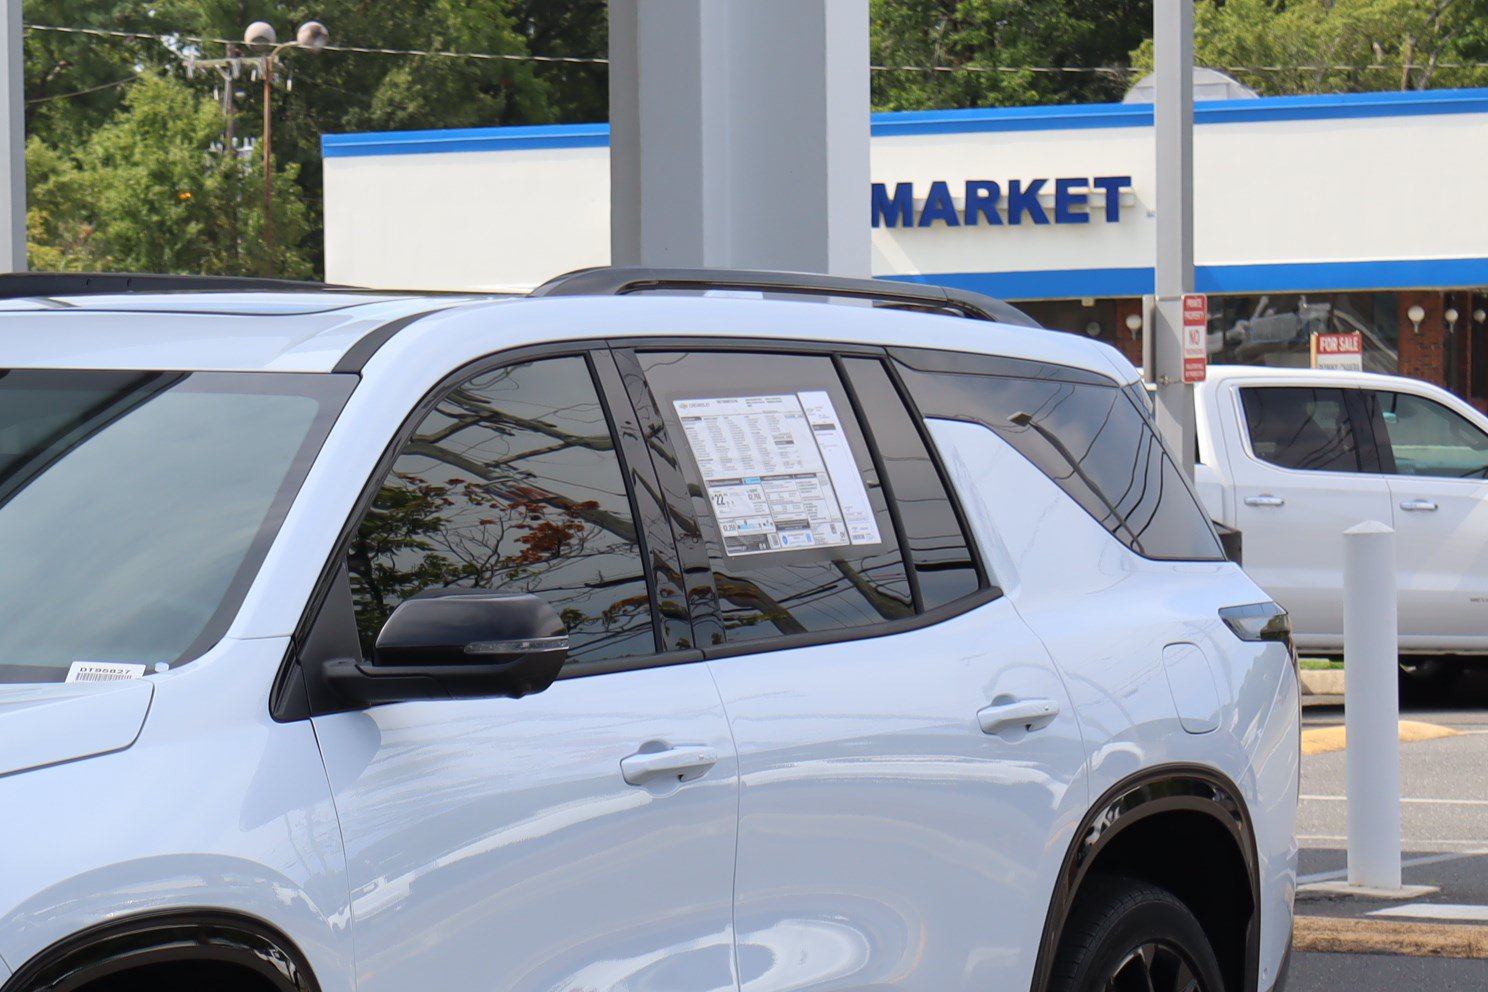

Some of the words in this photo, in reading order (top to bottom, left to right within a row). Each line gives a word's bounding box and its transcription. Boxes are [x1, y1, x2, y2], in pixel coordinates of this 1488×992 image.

[870, 175, 1132, 228] MARKET
[1319, 336, 1338, 352] FOR
[1339, 336, 1359, 352] SALE
